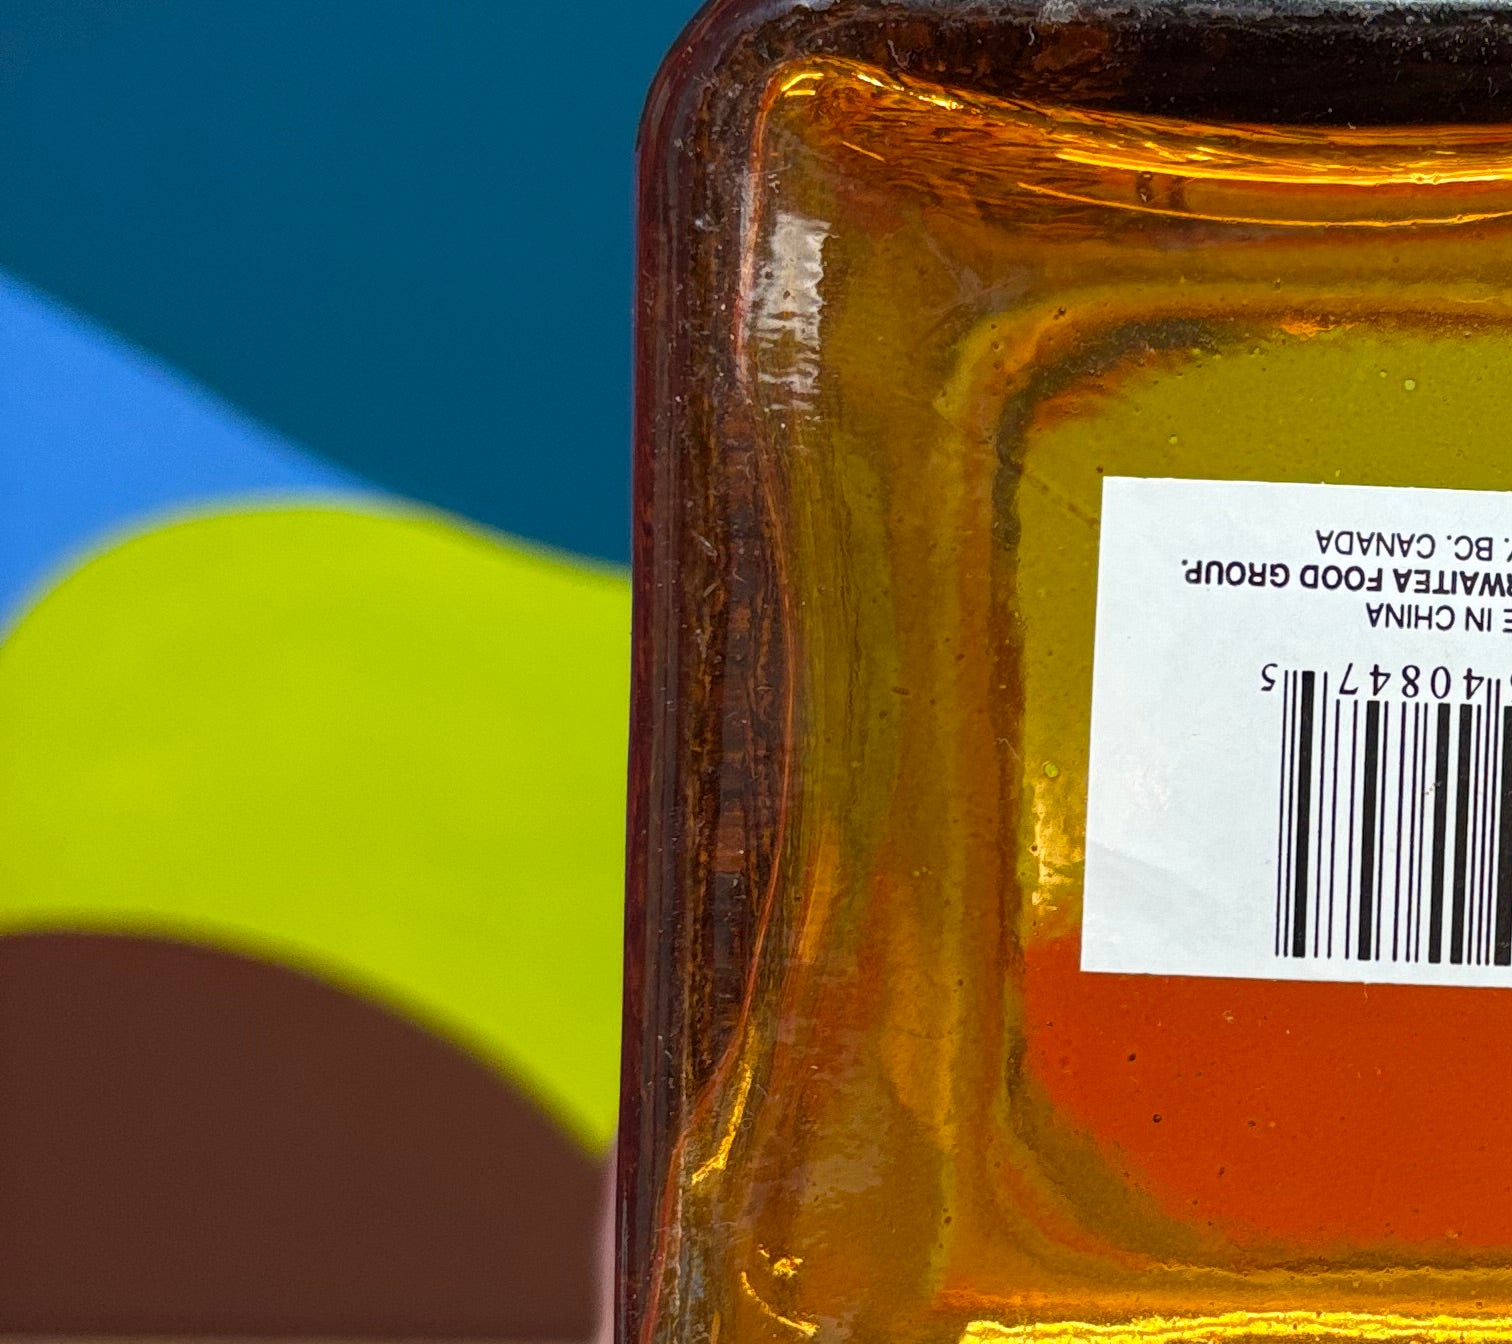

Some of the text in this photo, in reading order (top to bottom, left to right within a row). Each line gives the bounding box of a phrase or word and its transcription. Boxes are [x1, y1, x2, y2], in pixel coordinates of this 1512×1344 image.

[1315, 529, 1436, 559] CANADA
[1300, 564, 1383, 592] FOOD
[1365, 602, 1456, 631] CHINA
[1464, 606, 1492, 632] IN
[1260, 663, 1278, 692] 5
[1339, 662, 1485, 700] 40847
